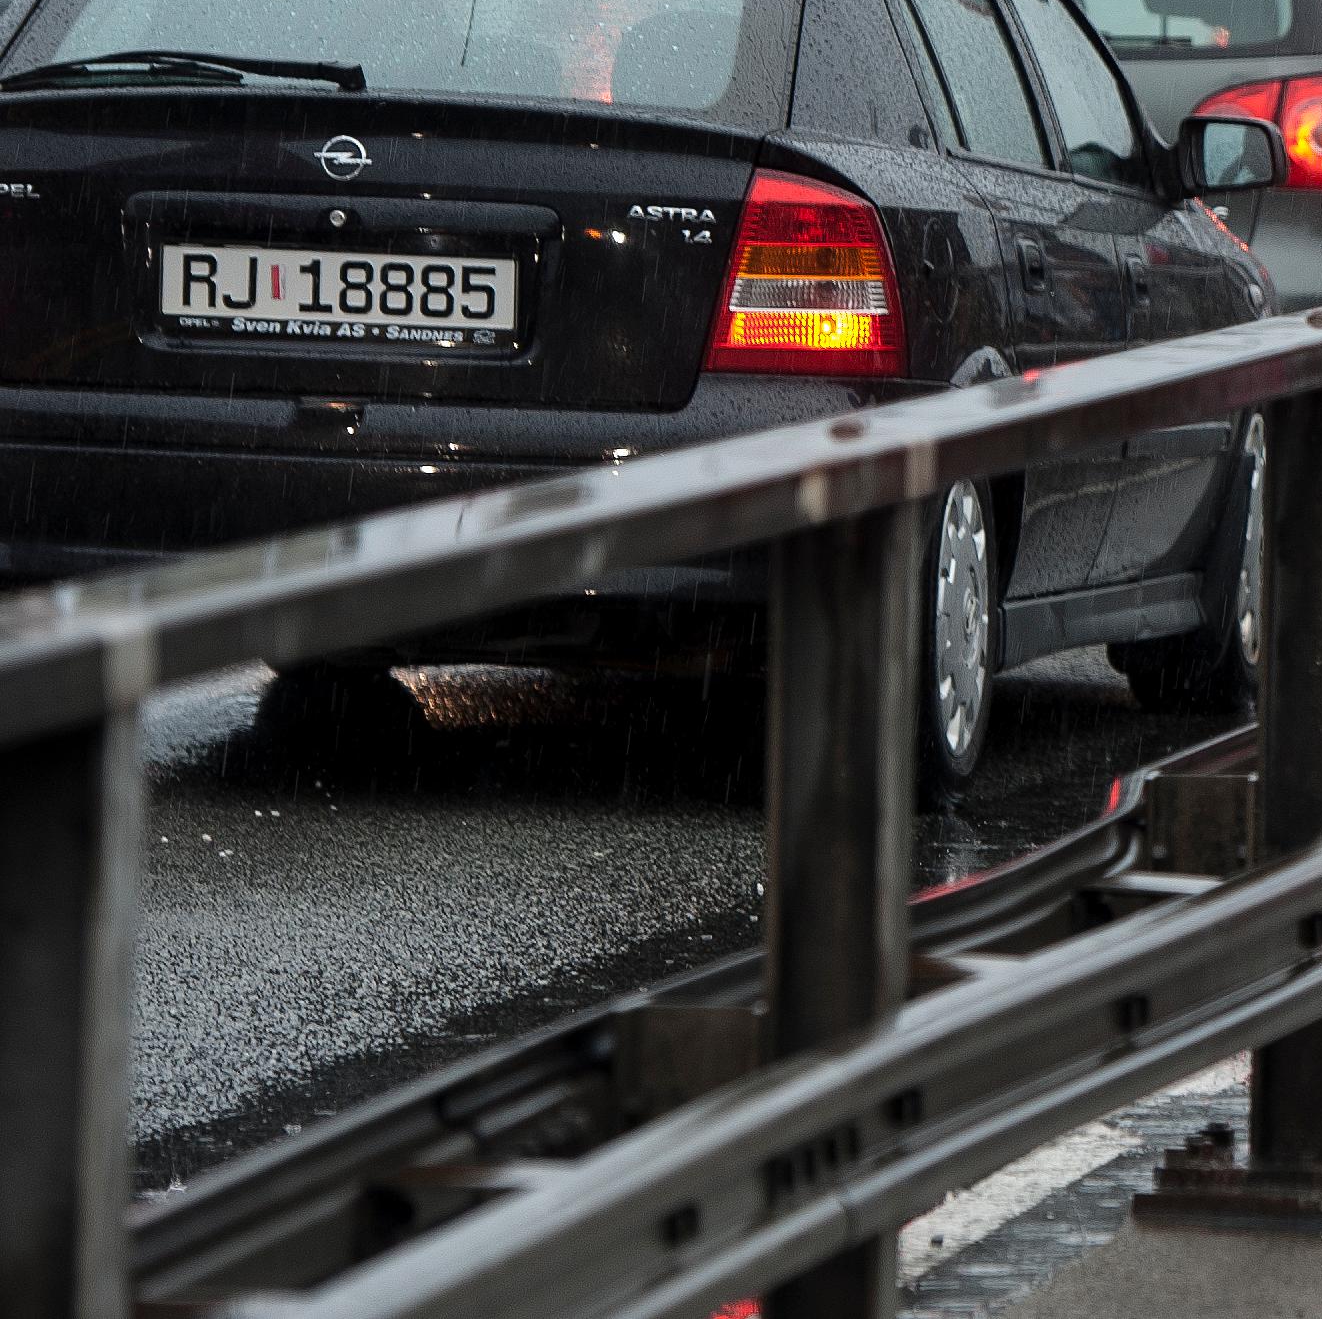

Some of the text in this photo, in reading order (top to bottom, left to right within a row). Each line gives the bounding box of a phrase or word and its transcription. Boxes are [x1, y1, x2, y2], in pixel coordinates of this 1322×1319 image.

[0, 183, 40, 198] PEL
[628, 205, 716, 223] ASTRA
[182, 253, 497, 319] RJ 18885
[231, 316, 464, 342] Sven Kvia AS SANDNES
